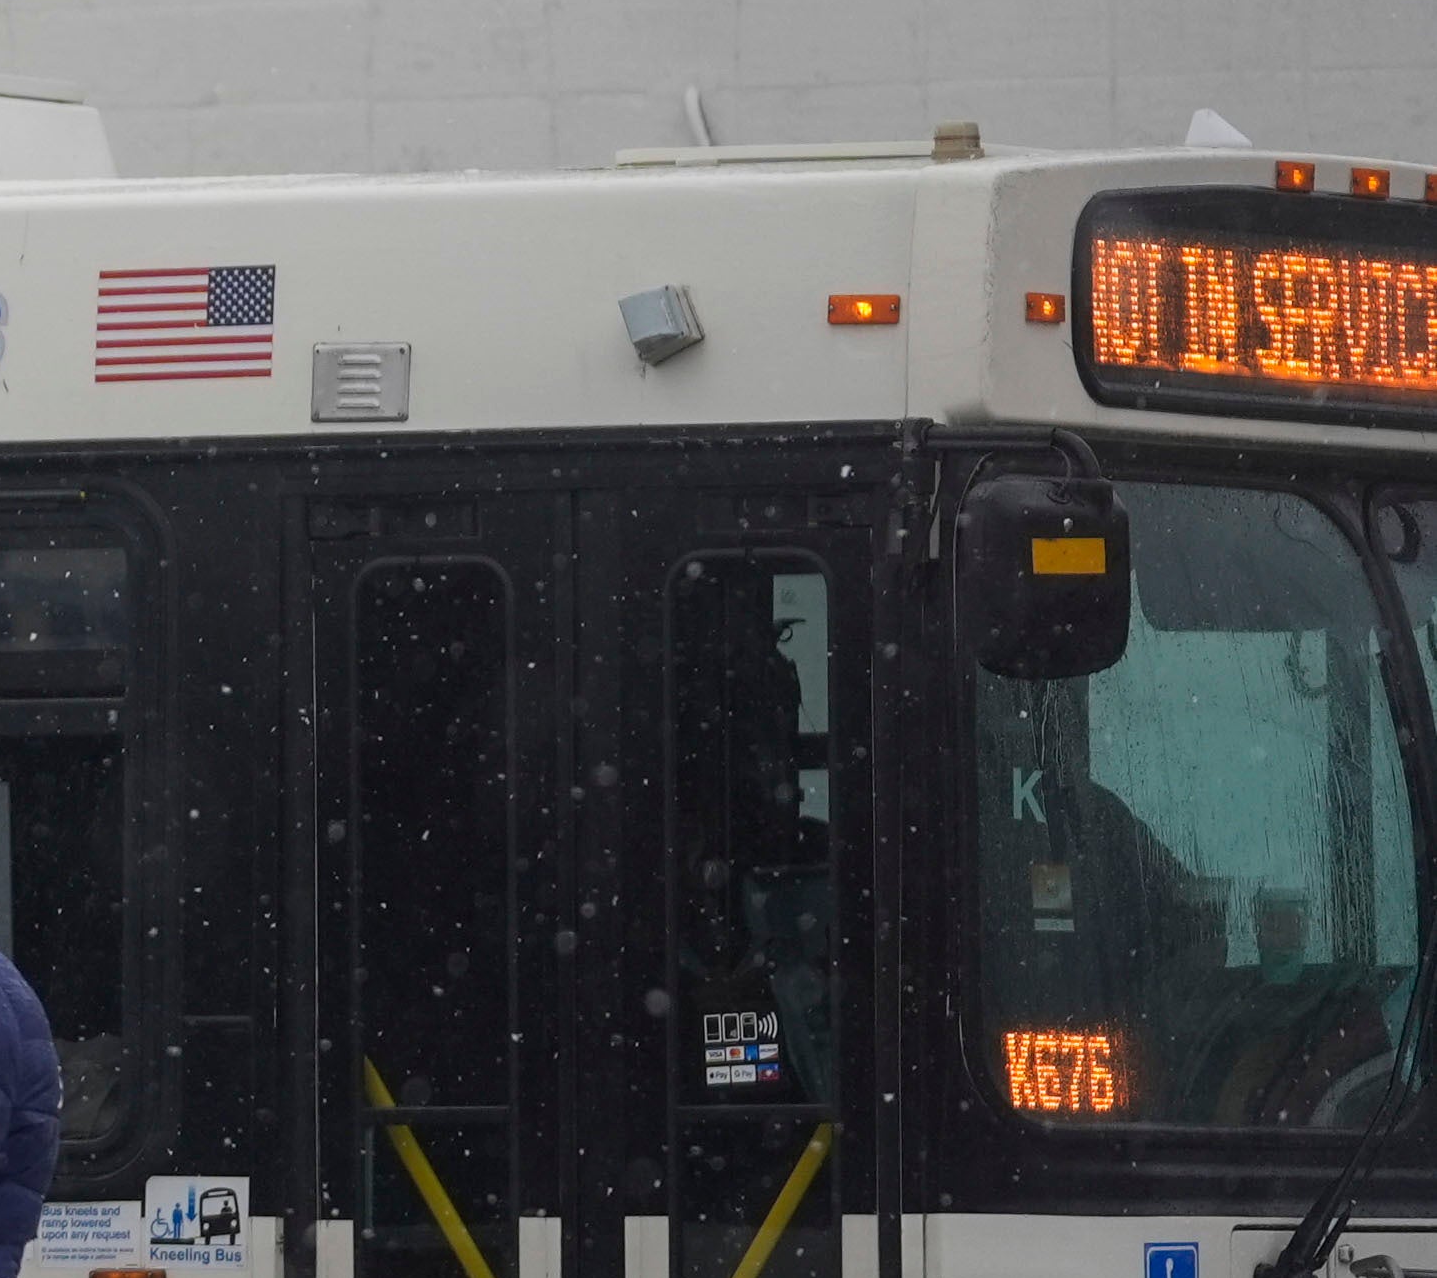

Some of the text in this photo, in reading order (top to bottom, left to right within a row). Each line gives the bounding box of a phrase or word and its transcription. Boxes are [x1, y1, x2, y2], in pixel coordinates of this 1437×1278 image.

[1181, 245, 1237, 373] IN
[41, 1205, 121, 1216] Bus kneels and
[41, 1218, 111, 1230] ramp lowered
[41, 1230, 131, 1242] upon any request
[149, 1247, 211, 1265] Kneeling
[215, 1247, 242, 1262] Bus
